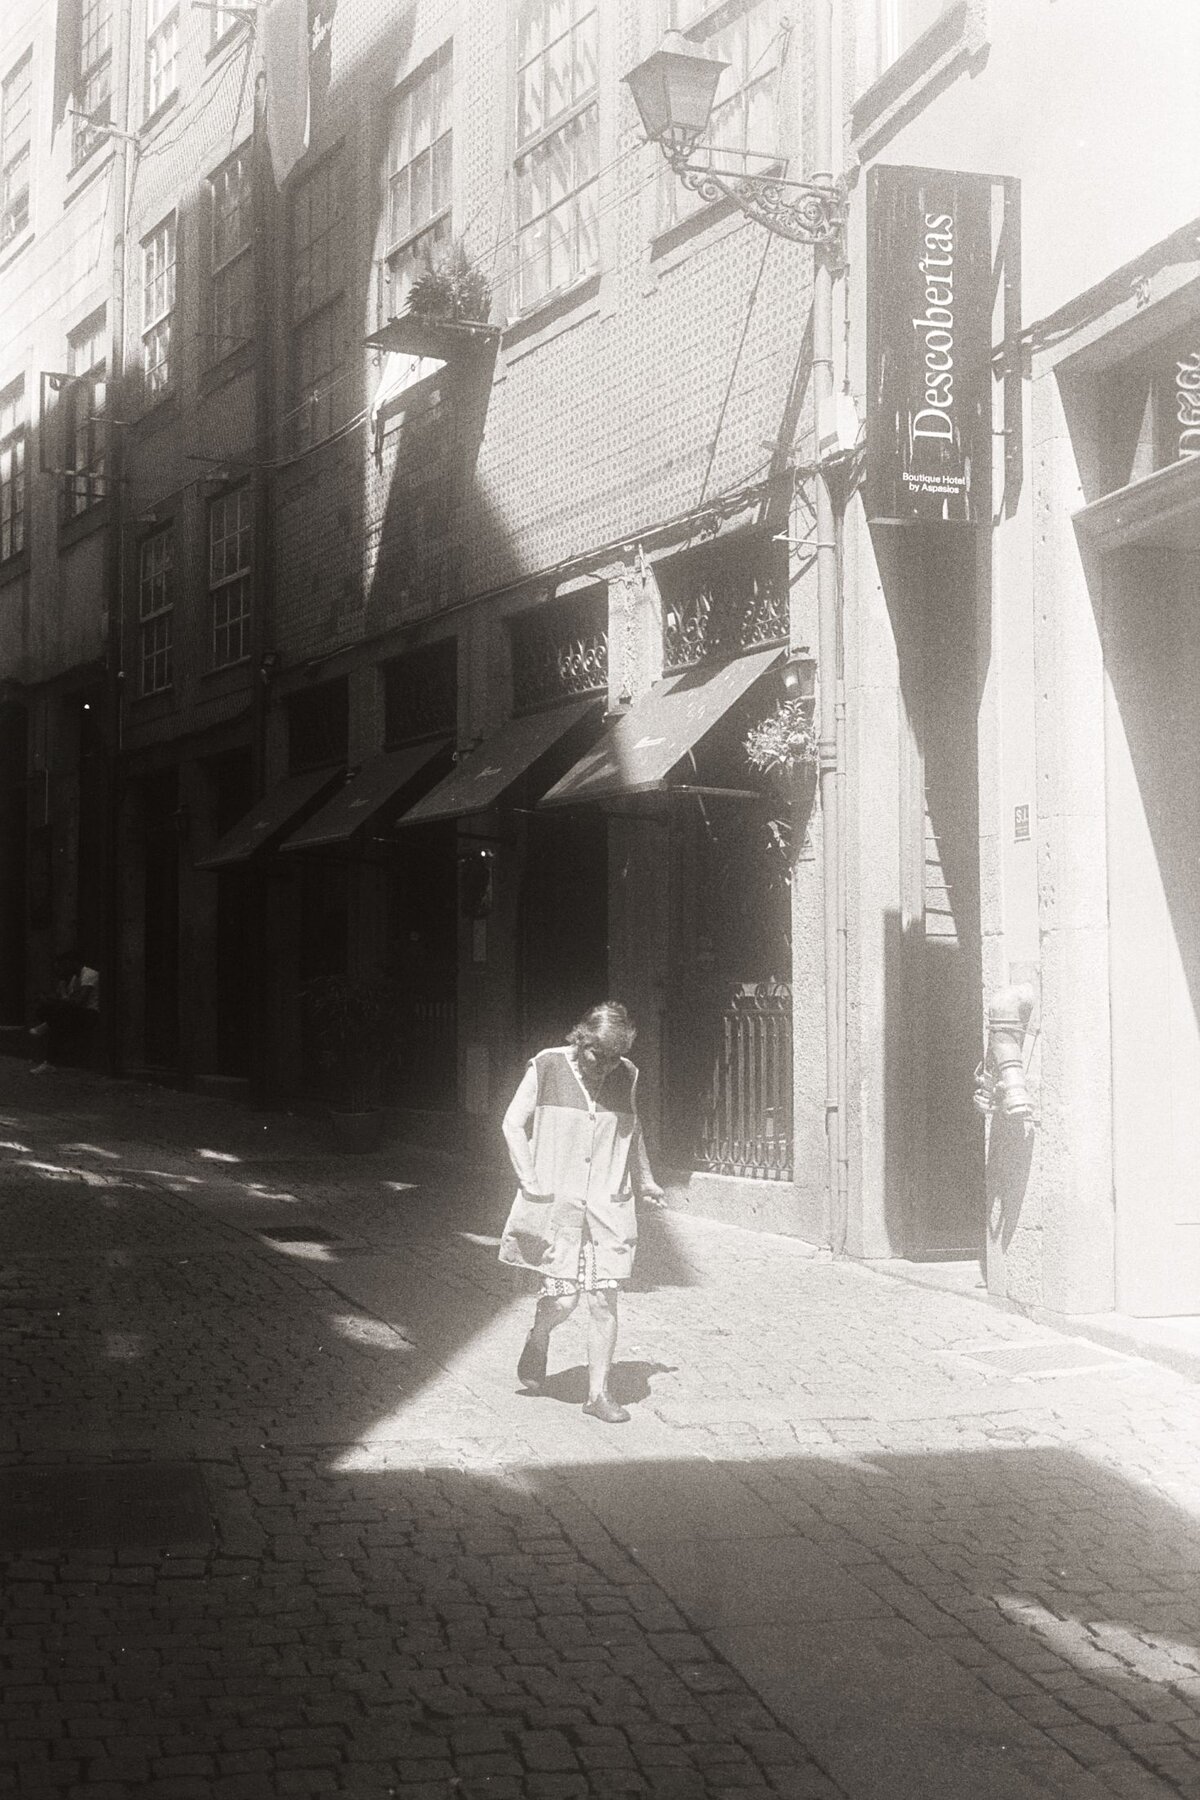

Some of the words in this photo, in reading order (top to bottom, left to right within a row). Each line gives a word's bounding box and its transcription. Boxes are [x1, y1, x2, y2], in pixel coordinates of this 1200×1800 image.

[913, 213, 953, 444] Descobertas
[902, 472, 941, 483] Boutique
[942, 475, 966, 485] Hotel
[909, 482, 920, 492] by
[921, 483, 959, 493] Aspasios
